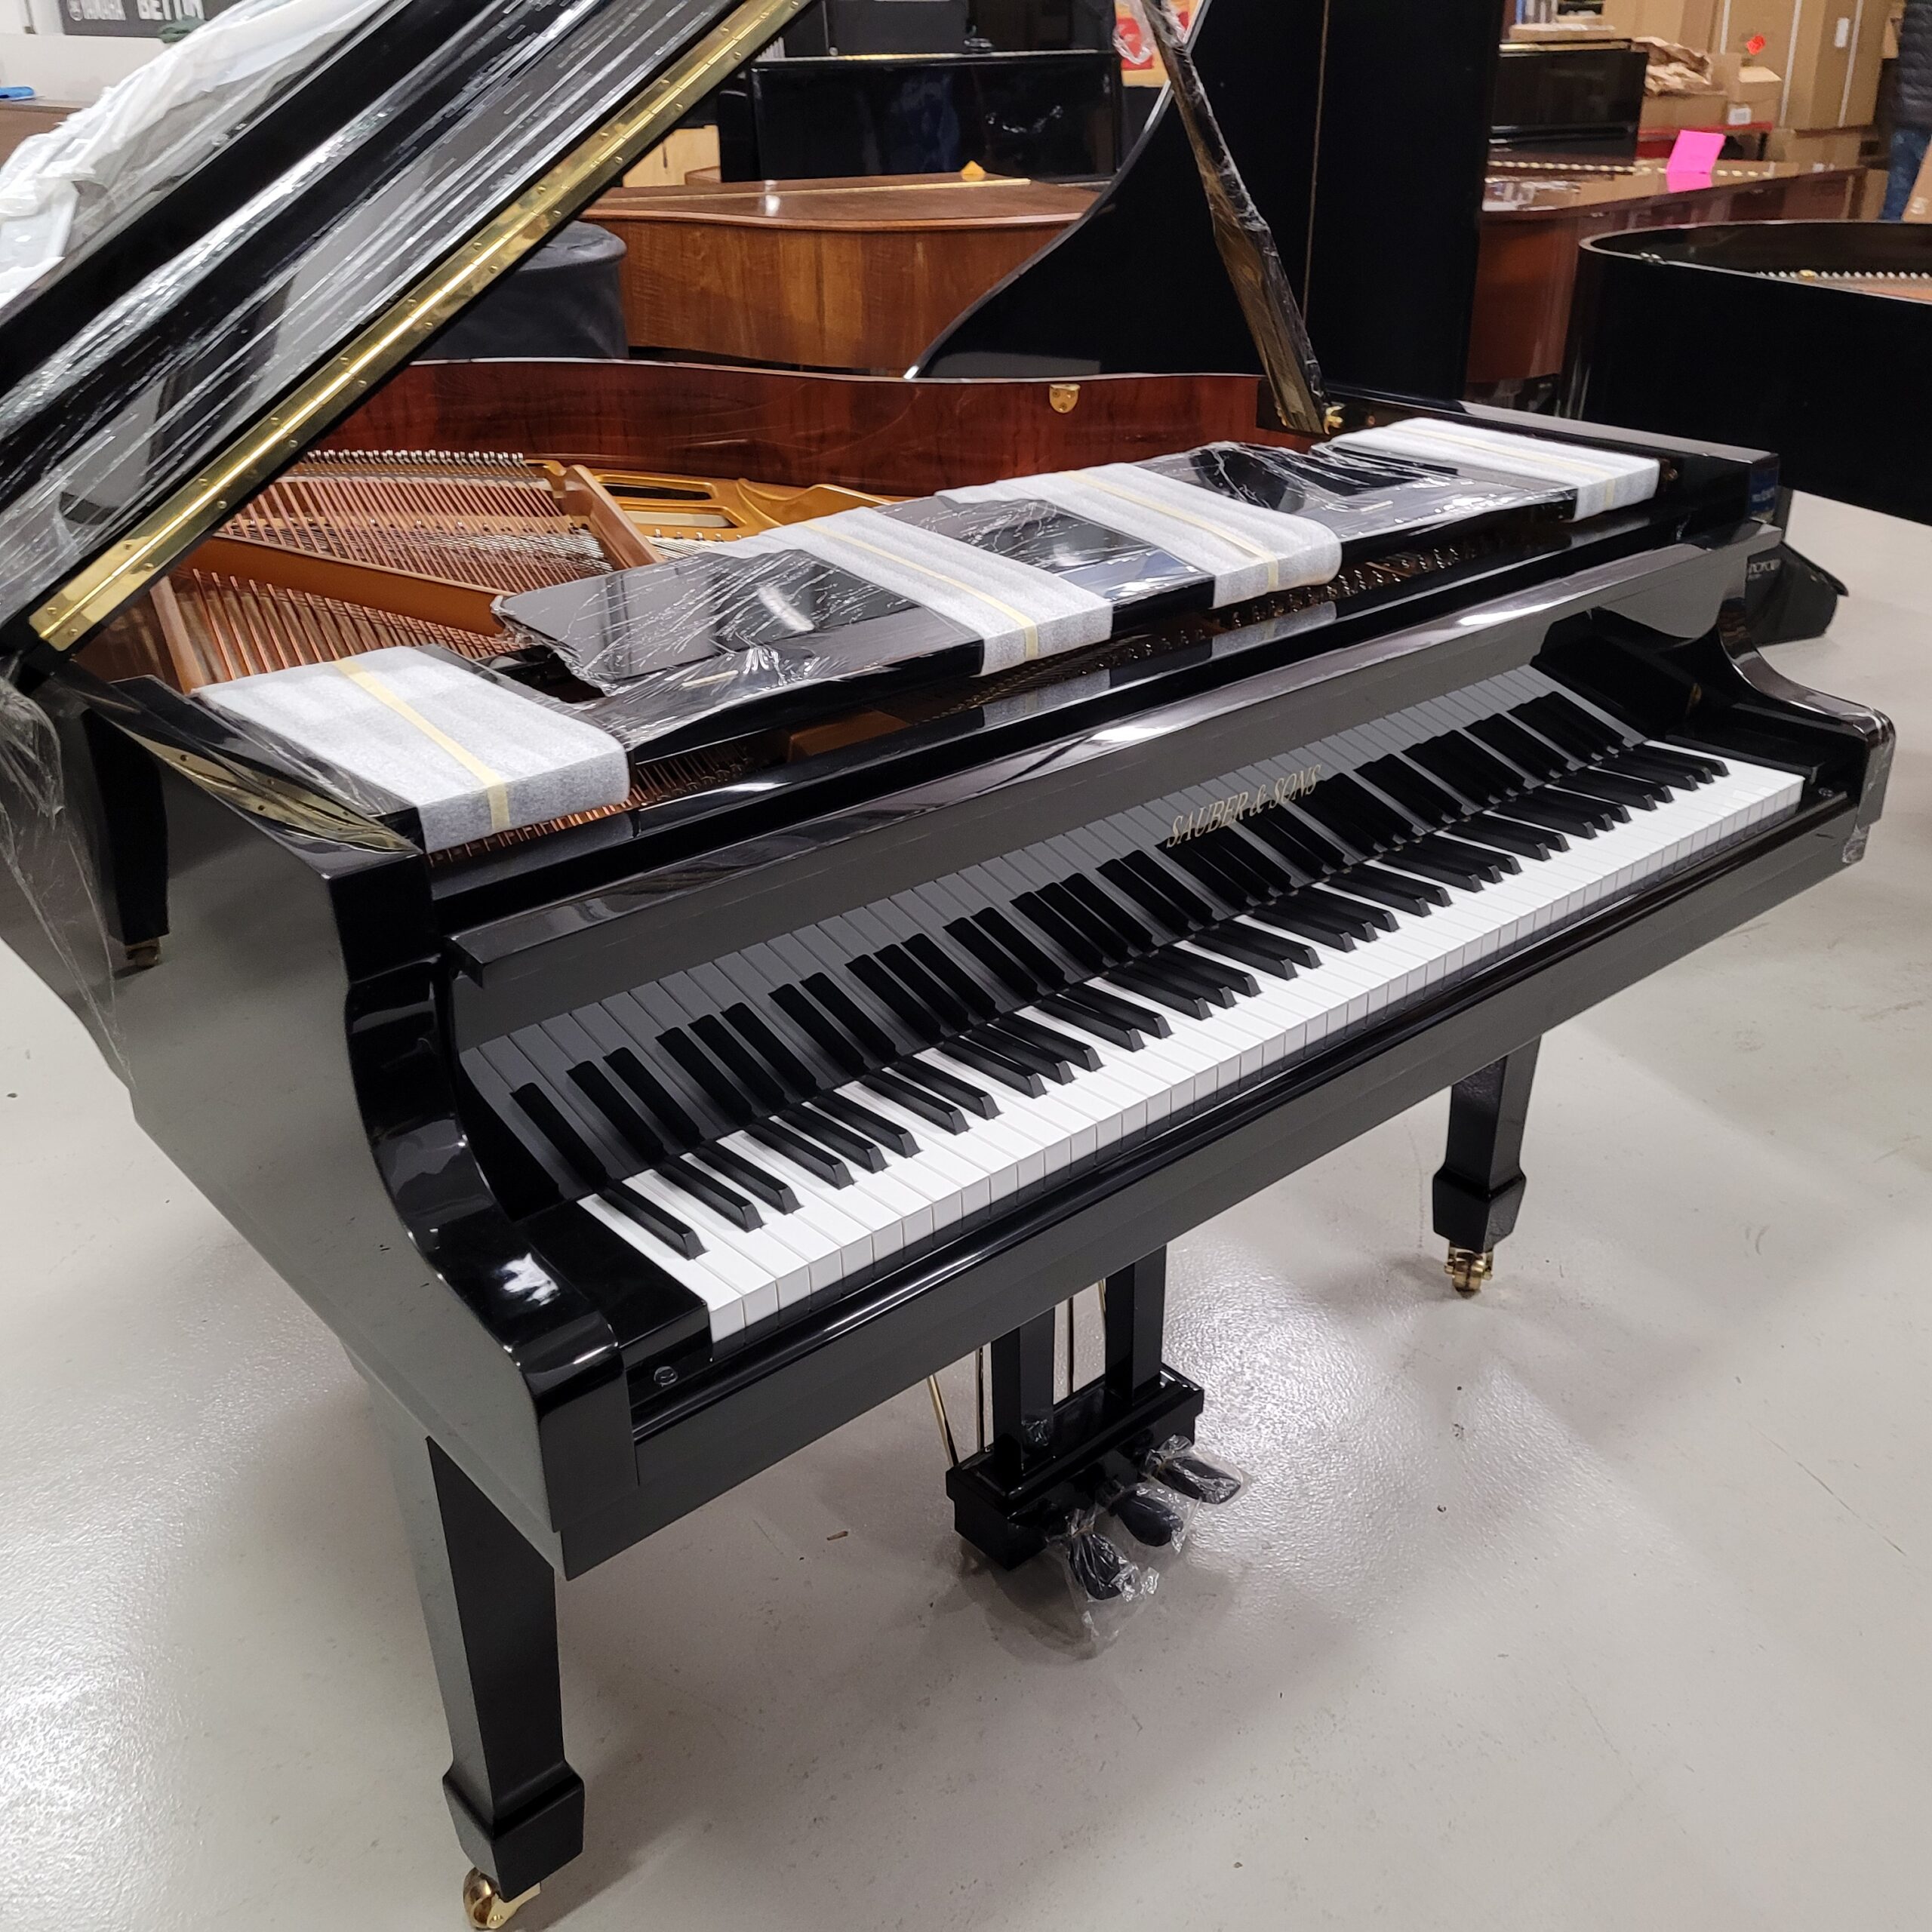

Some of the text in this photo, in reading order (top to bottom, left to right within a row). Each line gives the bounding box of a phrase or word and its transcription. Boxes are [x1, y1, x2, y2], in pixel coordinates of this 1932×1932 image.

[1166, 764, 1321, 848] SAUBER & SONS
